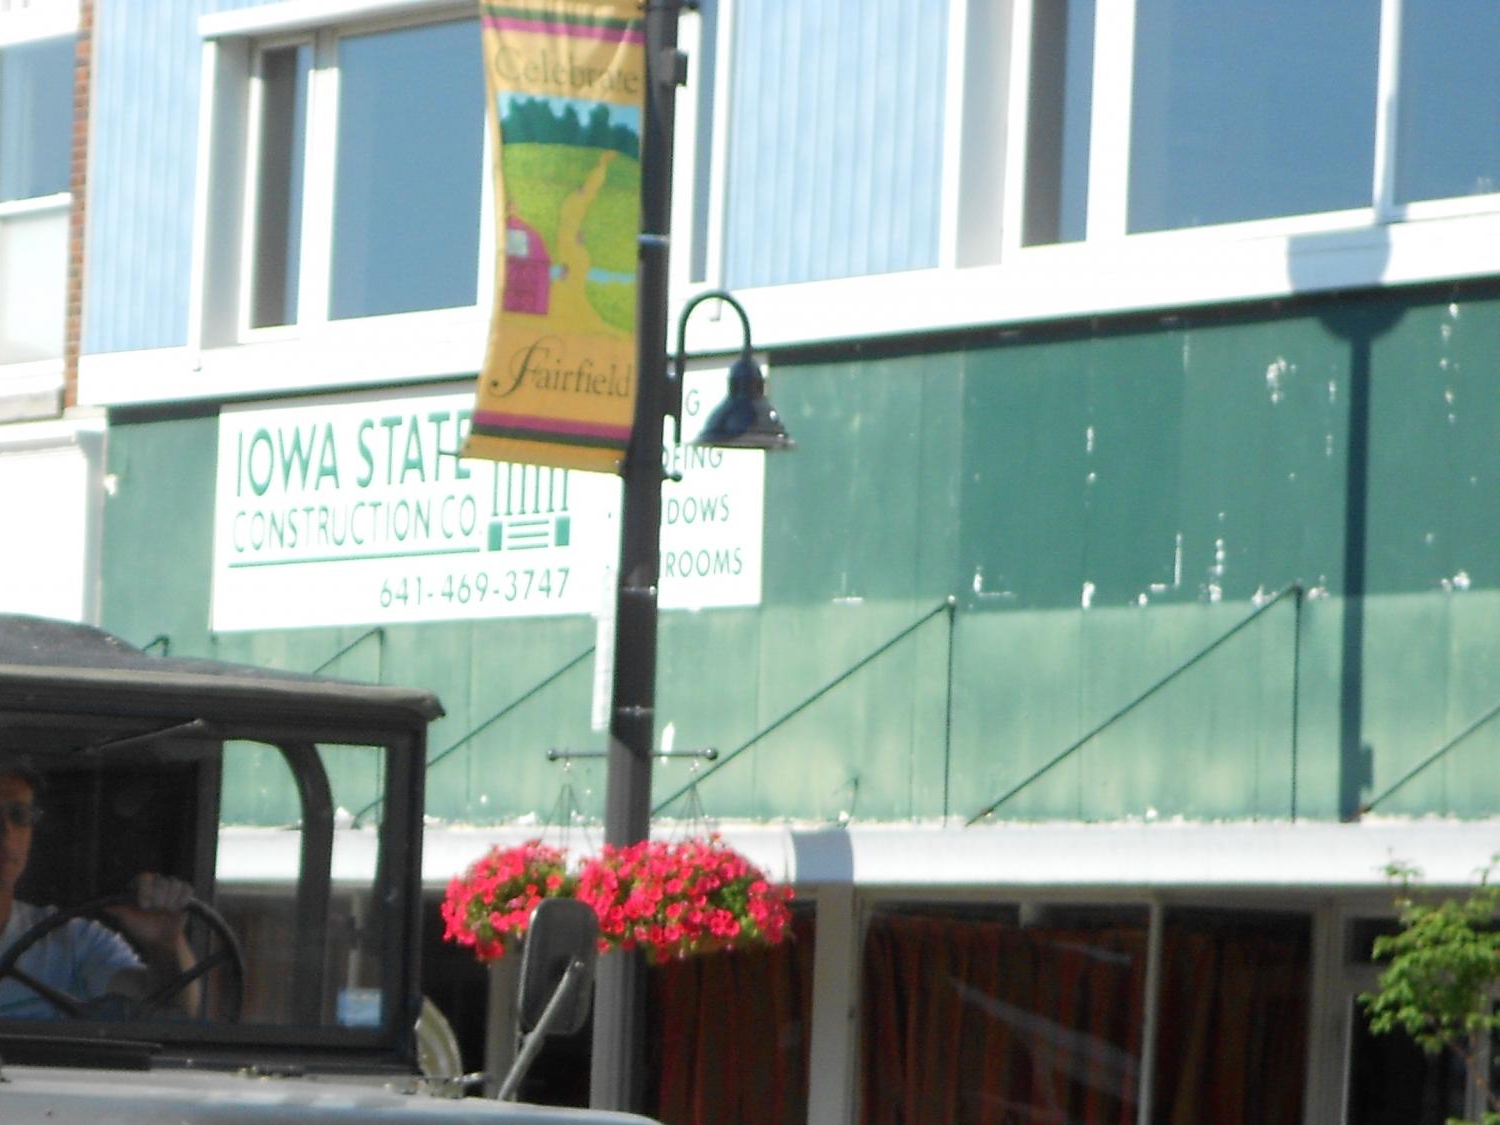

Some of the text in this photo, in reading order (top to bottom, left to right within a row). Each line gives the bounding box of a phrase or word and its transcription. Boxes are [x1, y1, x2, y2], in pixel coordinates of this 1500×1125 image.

[495, 46, 639, 94] Celebrate
[488, 335, 631, 398] Fairfield
[237, 410, 473, 497] IOWA STATE
[233, 498, 431, 553] CONSTRUCTION
[664, 494, 730, 525] DOWS
[663, 547, 743, 577] ROOMS
[379, 567, 571, 608] 641-469-3747
